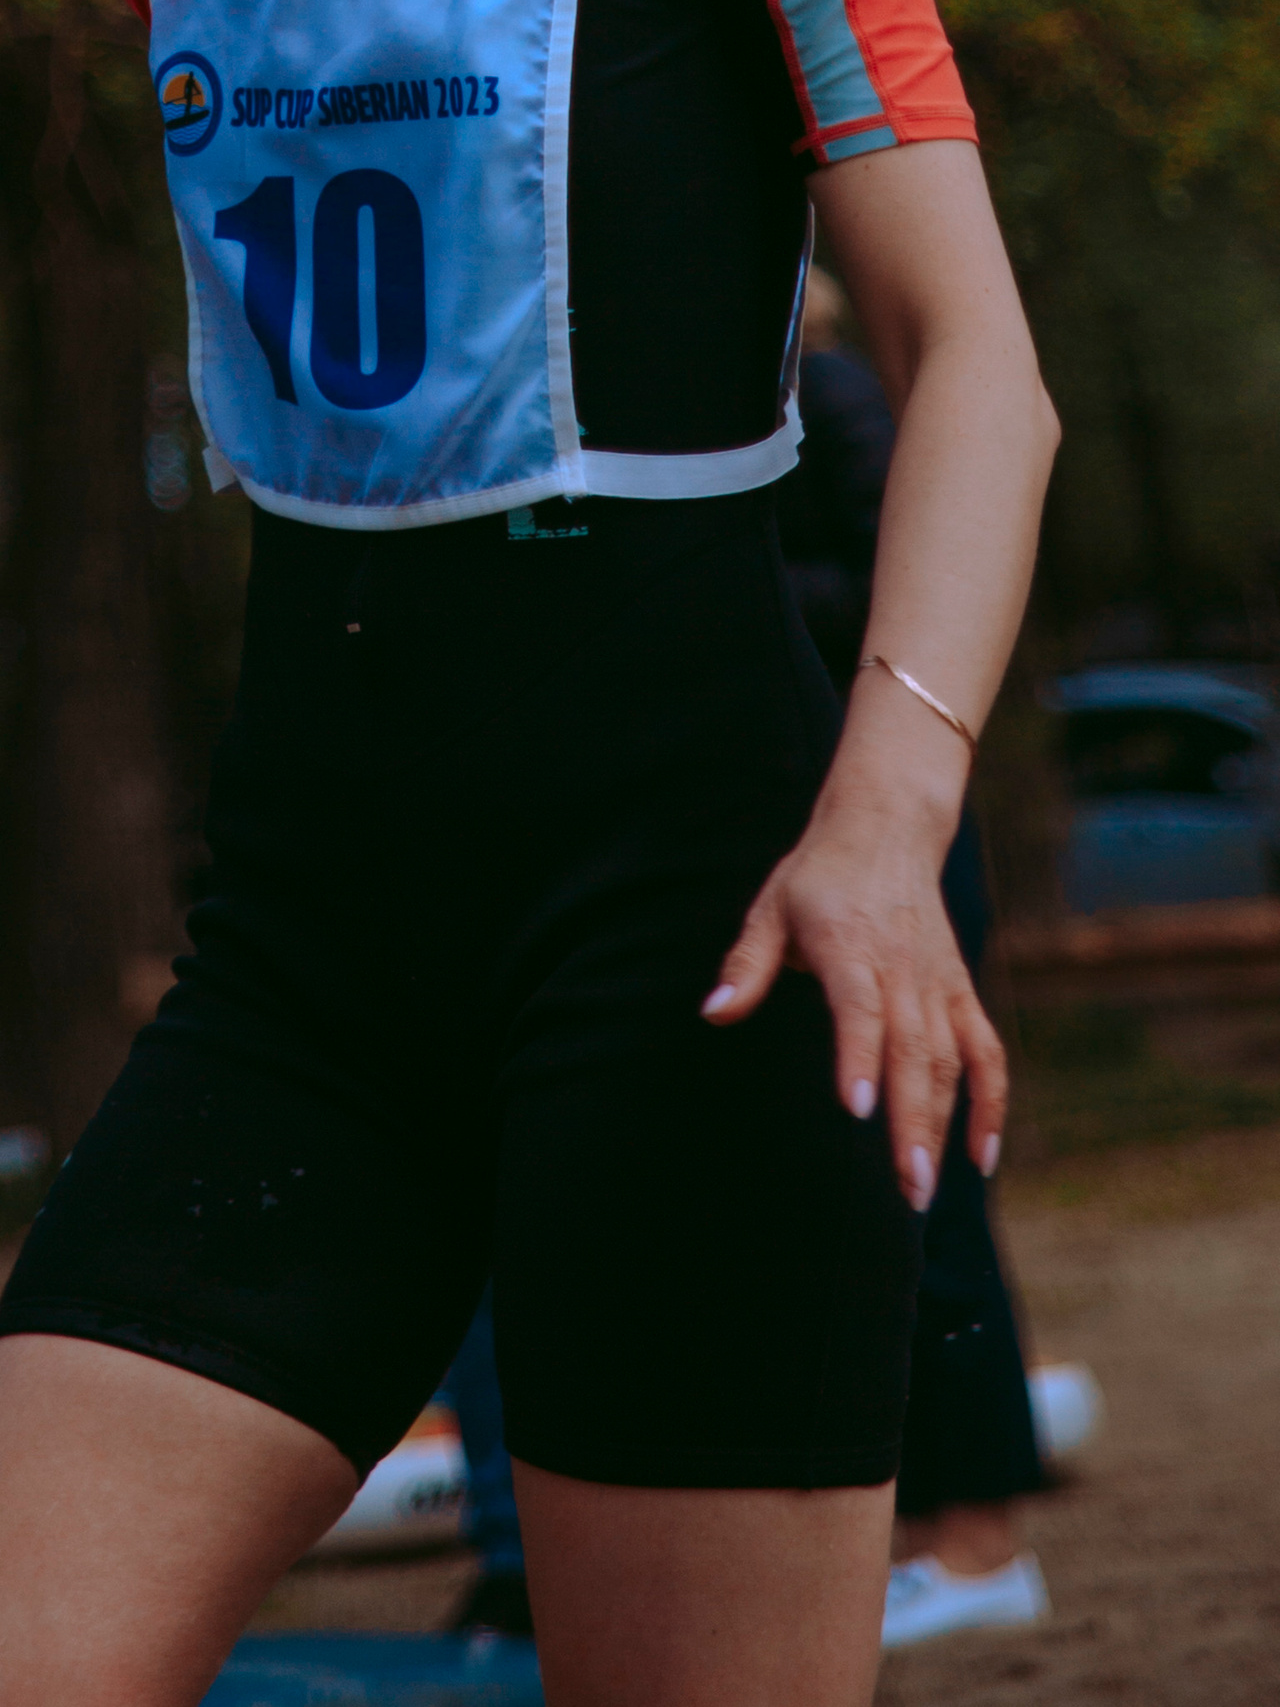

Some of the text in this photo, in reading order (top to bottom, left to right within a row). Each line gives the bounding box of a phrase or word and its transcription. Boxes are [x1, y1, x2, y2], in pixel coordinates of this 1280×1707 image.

[230, 75, 500, 129] SUP CUP SIBERIAN 2023
[214, 168, 427, 411] 10
